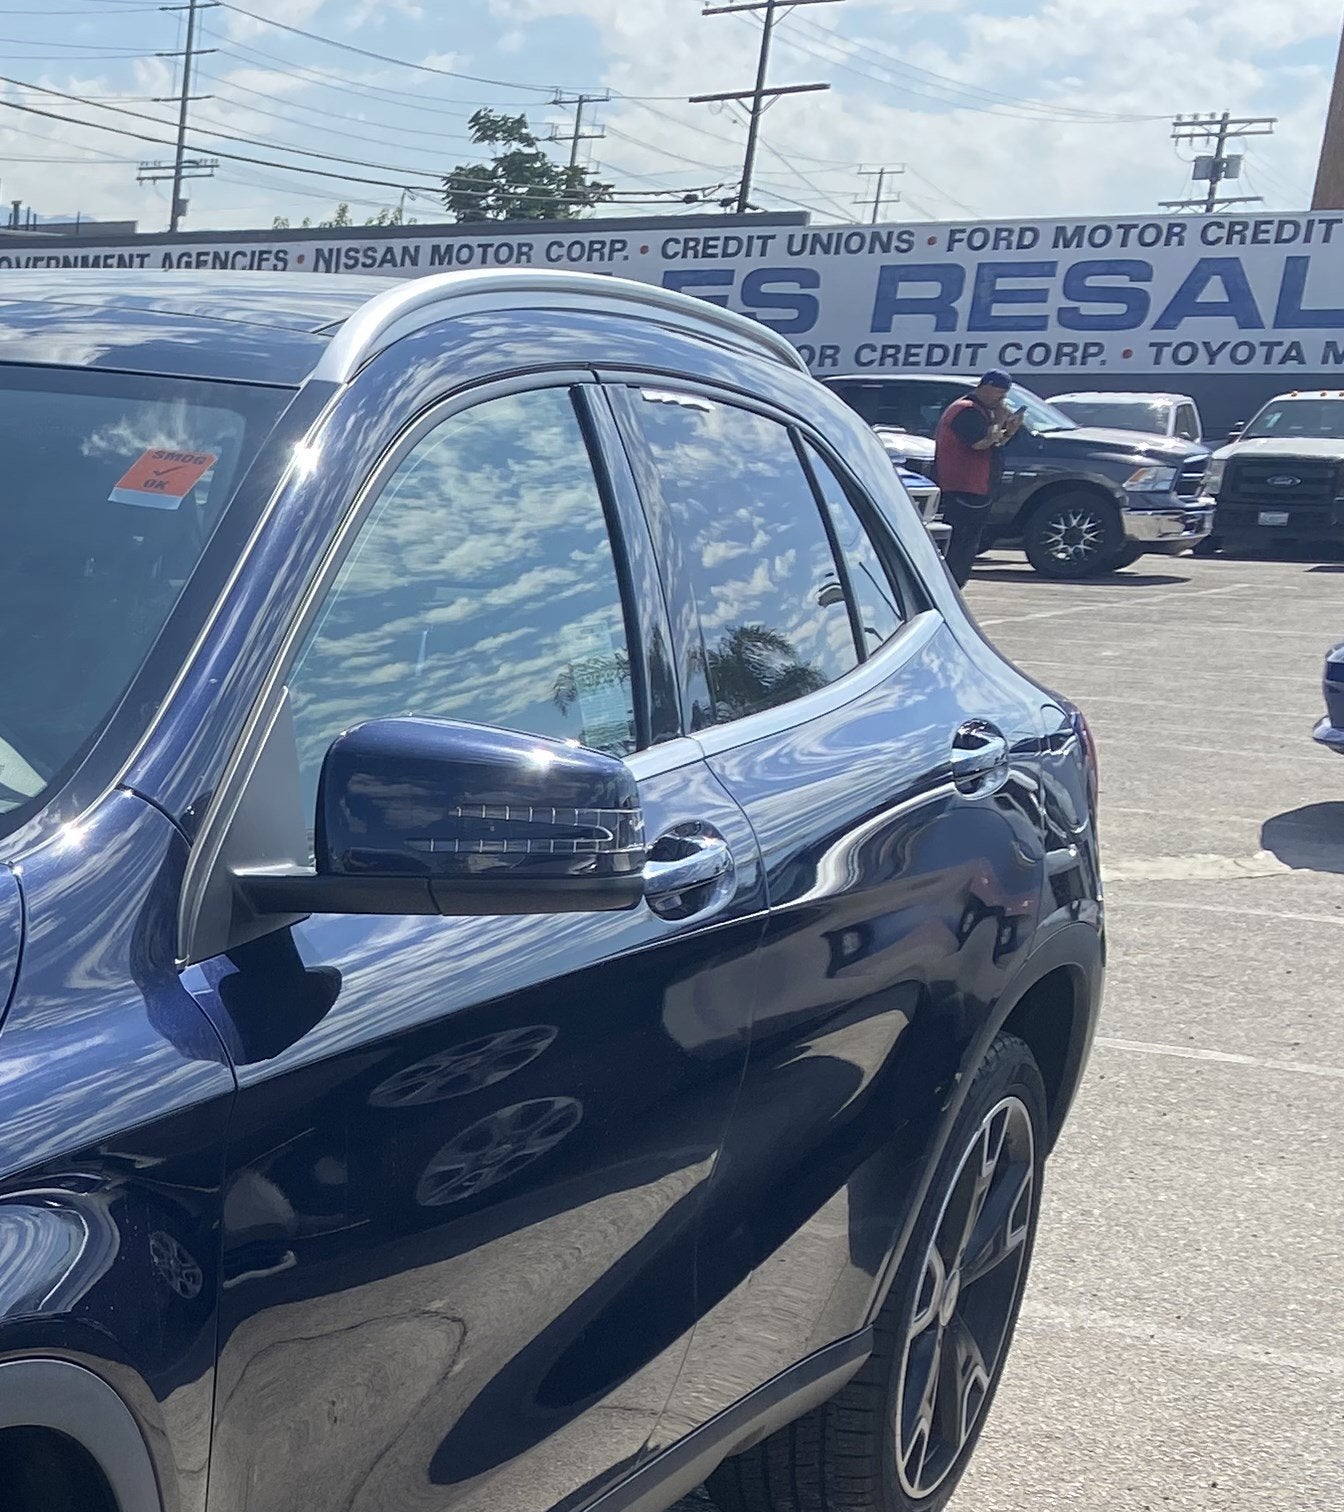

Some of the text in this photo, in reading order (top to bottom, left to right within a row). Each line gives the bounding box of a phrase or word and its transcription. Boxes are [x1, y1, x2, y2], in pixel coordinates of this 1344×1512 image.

[162, 249, 288, 272] AGENCIES
[313, 245, 420, 273] NISSAN
[429, 242, 533, 266] MOTOR
[545, 239, 629, 263] CORP.
[661, 234, 776, 260] CREDIT
[786, 230, 916, 256] UNIONS
[946, 225, 1041, 252] FORD
[1052, 222, 1188, 250] MOTOR
[1200, 218, 1343, 246] CREDIT
[663, 255, 1344, 335] ES RESAL
[855, 343, 987, 368] CREDIT
[998, 342, 1107, 367] CORP.
[1148, 340, 1307, 366] TOYOTA
[152, 450, 207, 465] SMOG
[143, 479, 169, 490] OK
